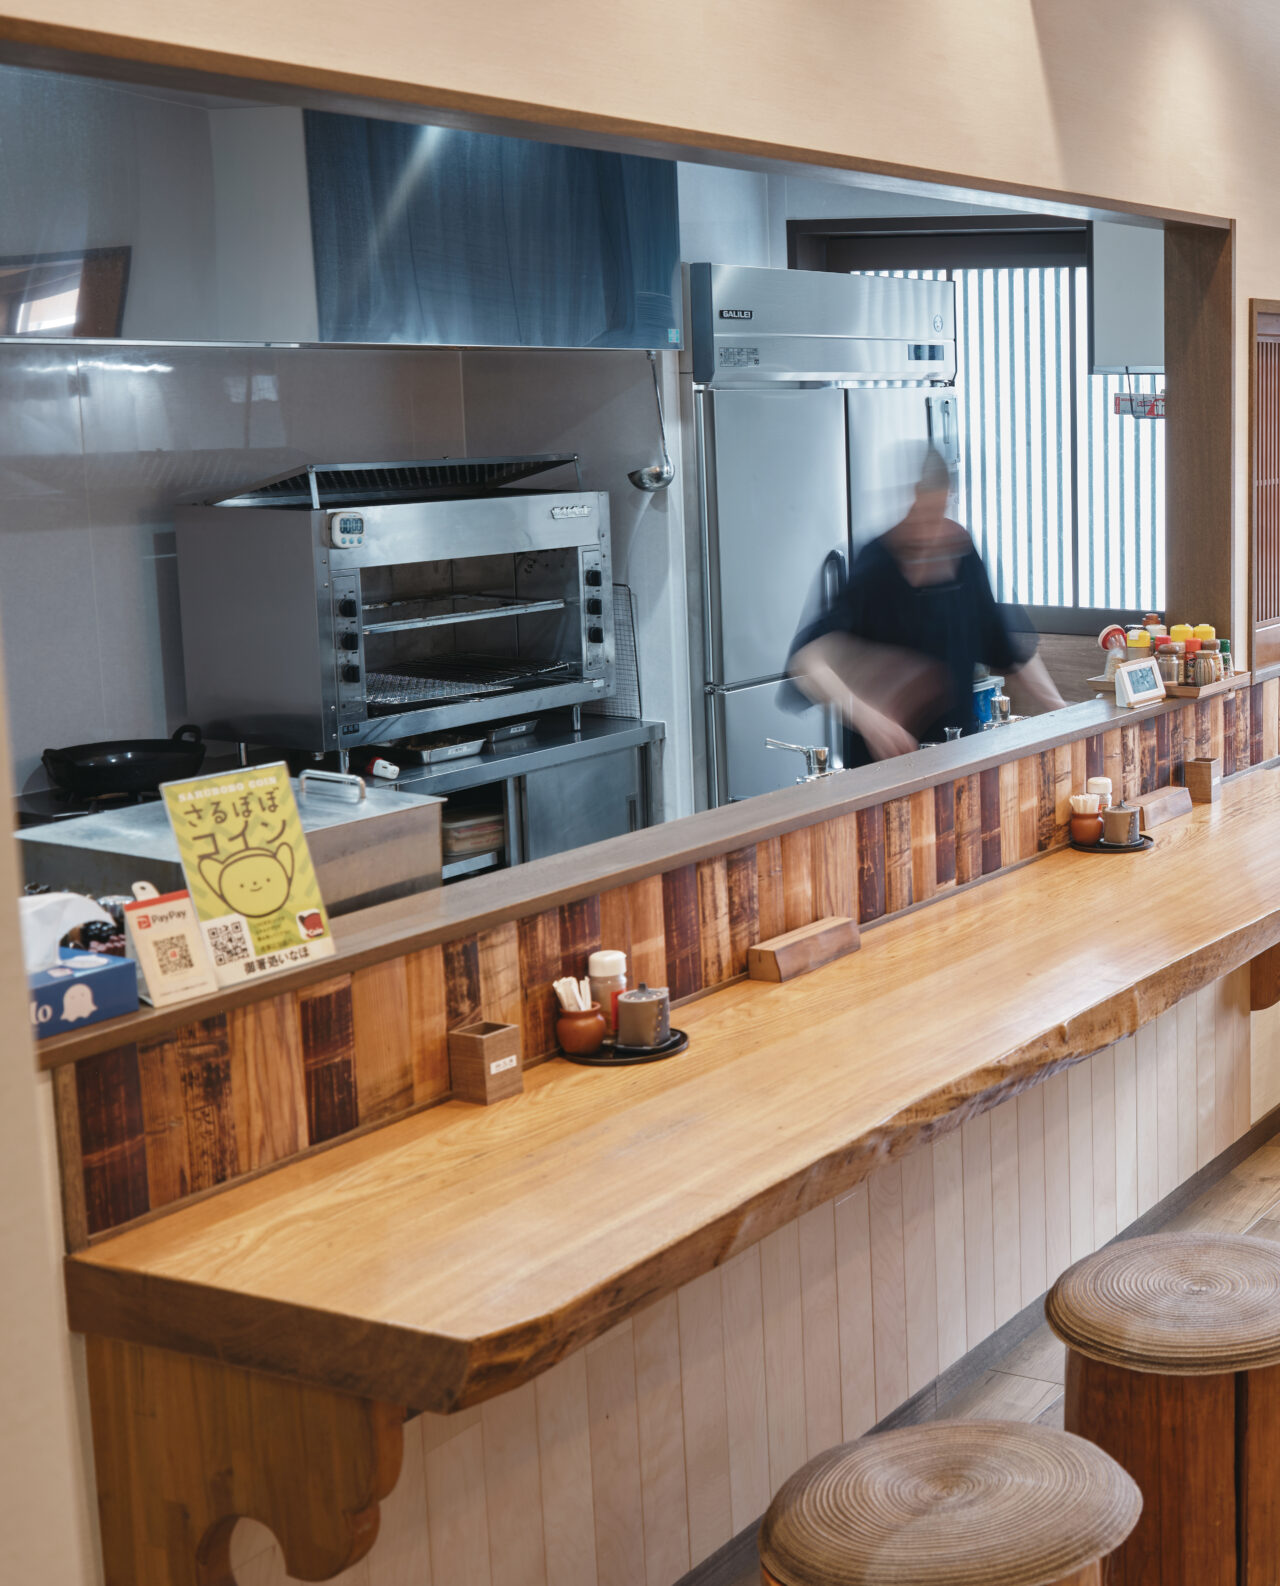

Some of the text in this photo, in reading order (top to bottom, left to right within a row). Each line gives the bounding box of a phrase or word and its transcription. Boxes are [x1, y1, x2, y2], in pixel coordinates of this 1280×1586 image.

[722, 310, 751, 318] GALILEI
[248, 776, 277, 789] COIN
[184, 787, 280, 827] さるぼぼ
[192, 819, 287, 858] コイン
[151, 910, 186, 923] PayPay
